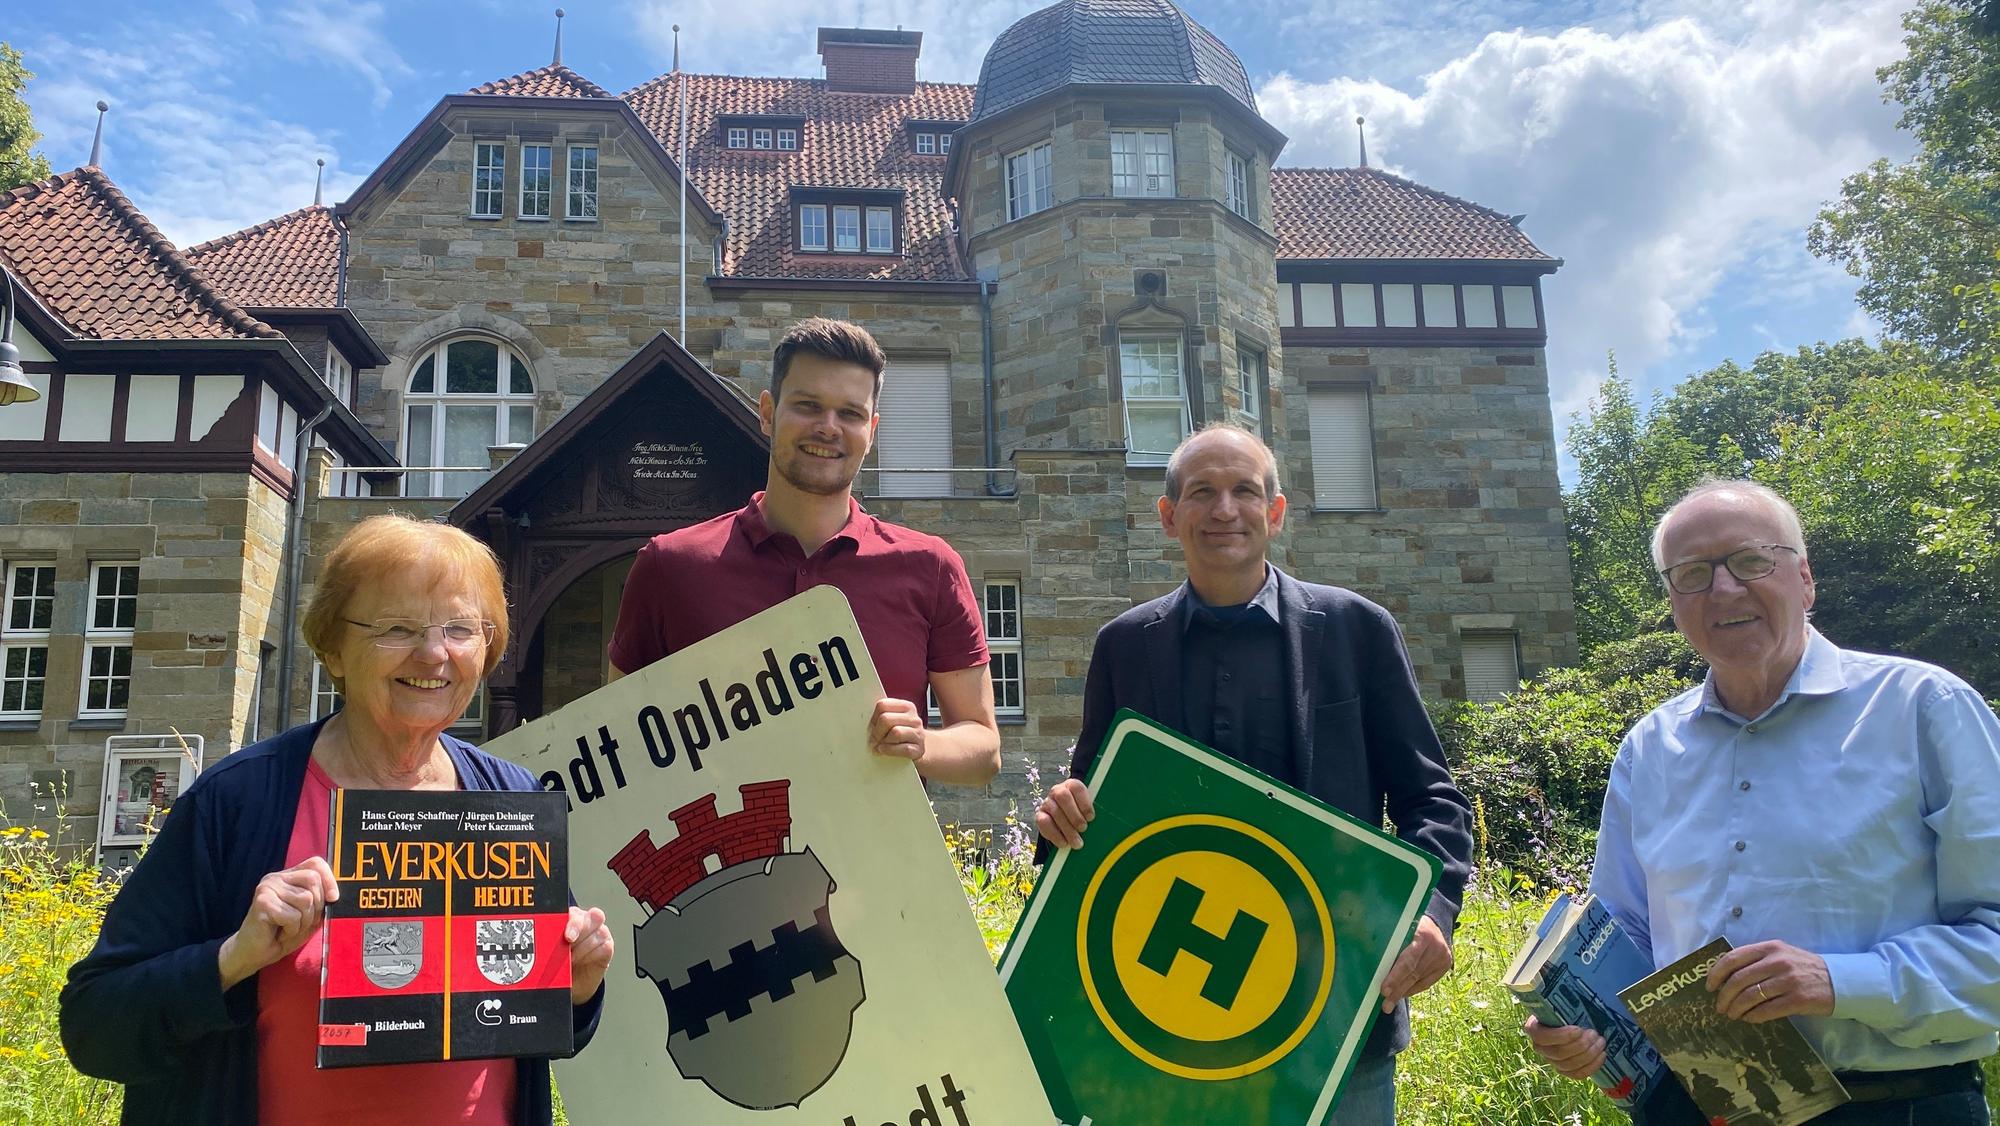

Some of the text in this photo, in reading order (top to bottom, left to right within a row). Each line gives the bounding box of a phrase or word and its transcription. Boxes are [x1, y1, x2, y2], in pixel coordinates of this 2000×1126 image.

[539, 635, 860, 812] adt Opladen
[361, 821, 535, 832] Lothar Meyer Peter Kaczmarek
[362, 811, 535, 822] Hans Georg Schaffner Jürgen Dehniger
[334, 841, 550, 881] LEVERKUSEN
[359, 887, 423, 909] GESTERN
[474, 886, 535, 906] HEUTE
[1137, 876, 1270, 1012] H
[1581, 917, 1618, 965] Opladen
[374, 1018, 426, 1032] Bilderbuch
[509, 1014, 538, 1025] Braun
